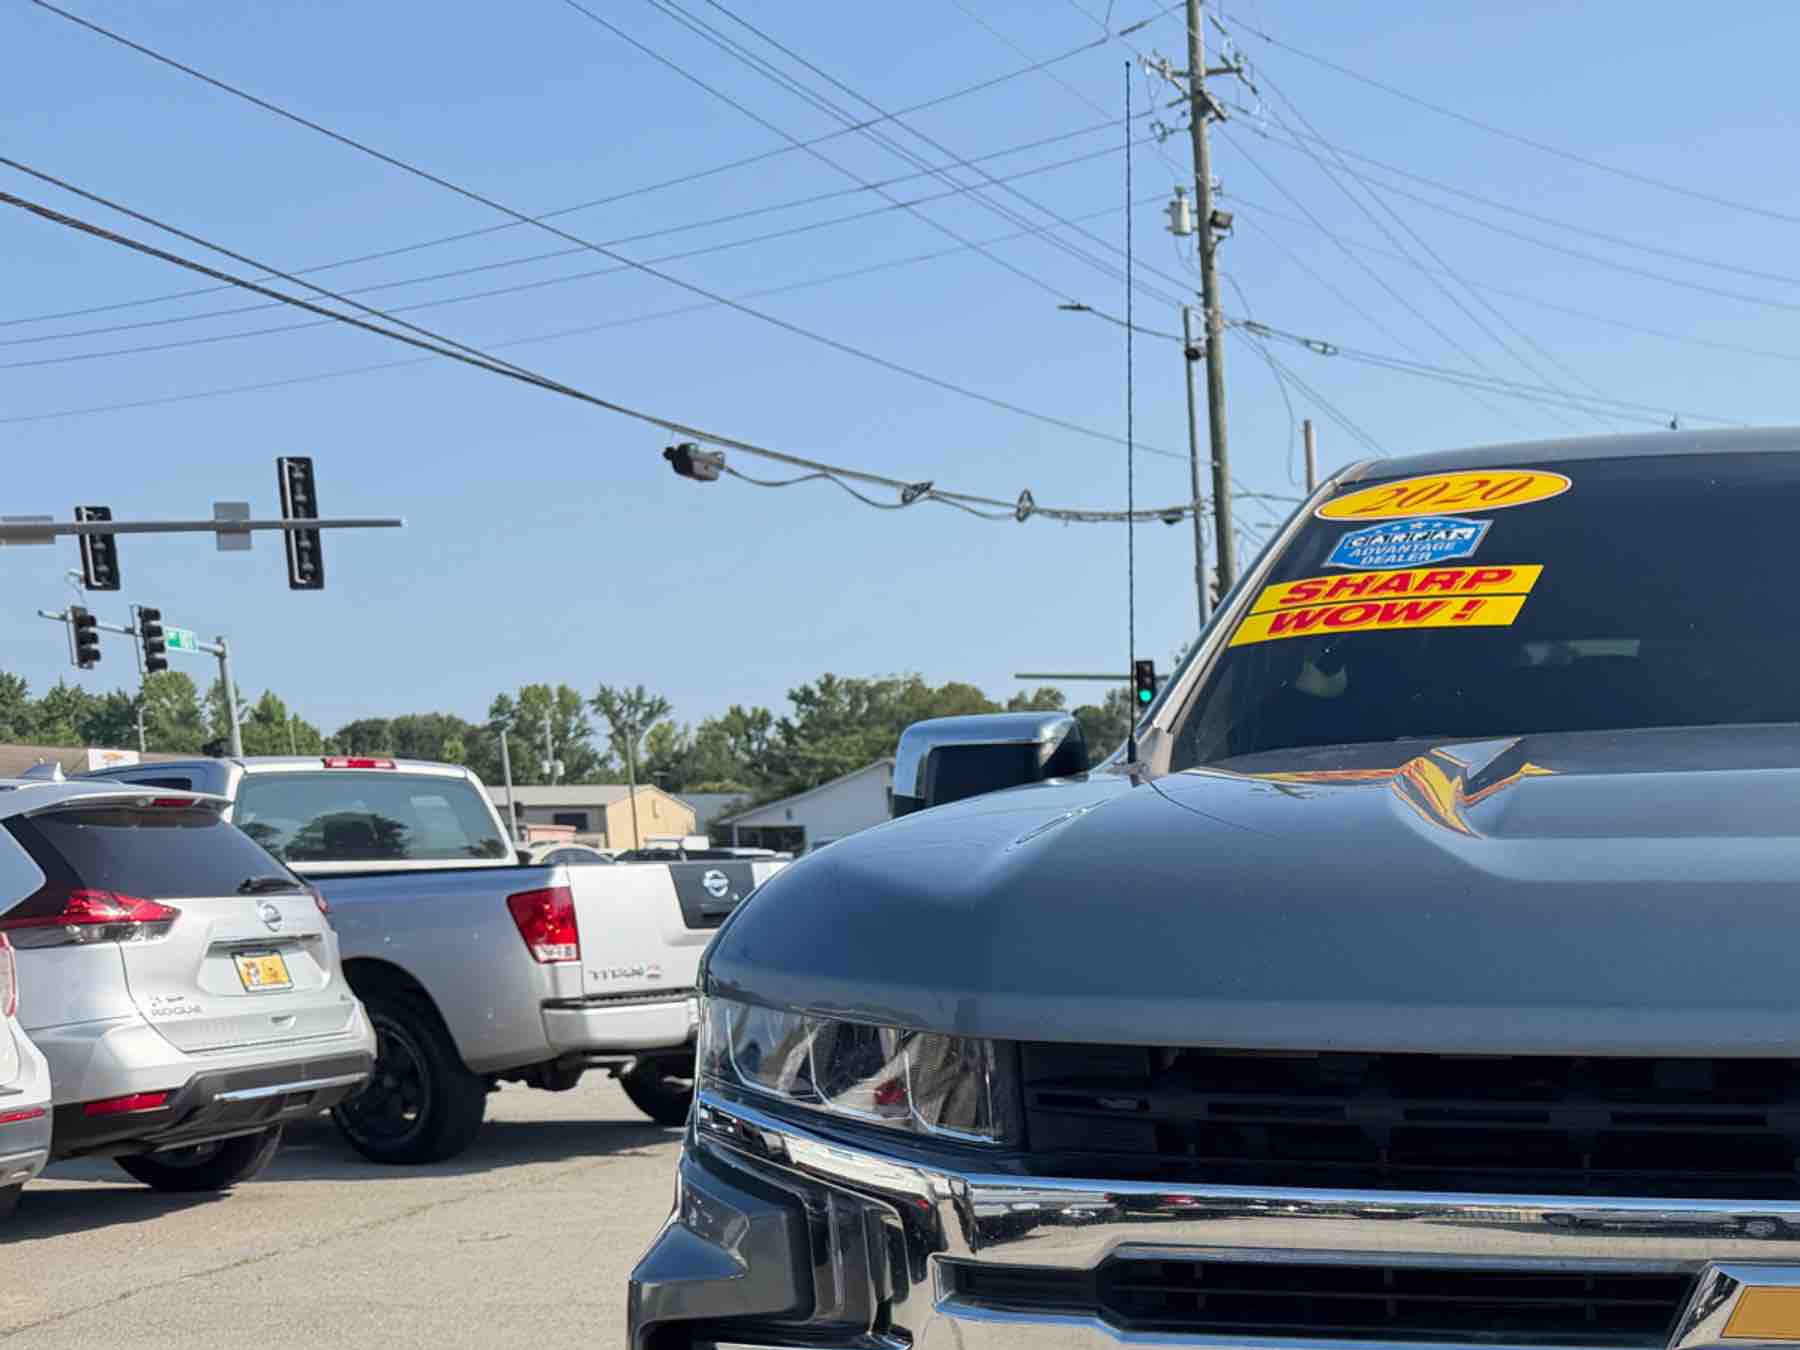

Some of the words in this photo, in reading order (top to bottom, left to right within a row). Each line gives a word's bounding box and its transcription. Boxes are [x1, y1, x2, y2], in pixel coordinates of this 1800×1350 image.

[1350, 475, 1535, 515] 2020
[1348, 541, 1456, 558] ADVANTAGE
[1360, 551, 1432, 565] DEALER
[1279, 567, 1514, 606] SHARP
